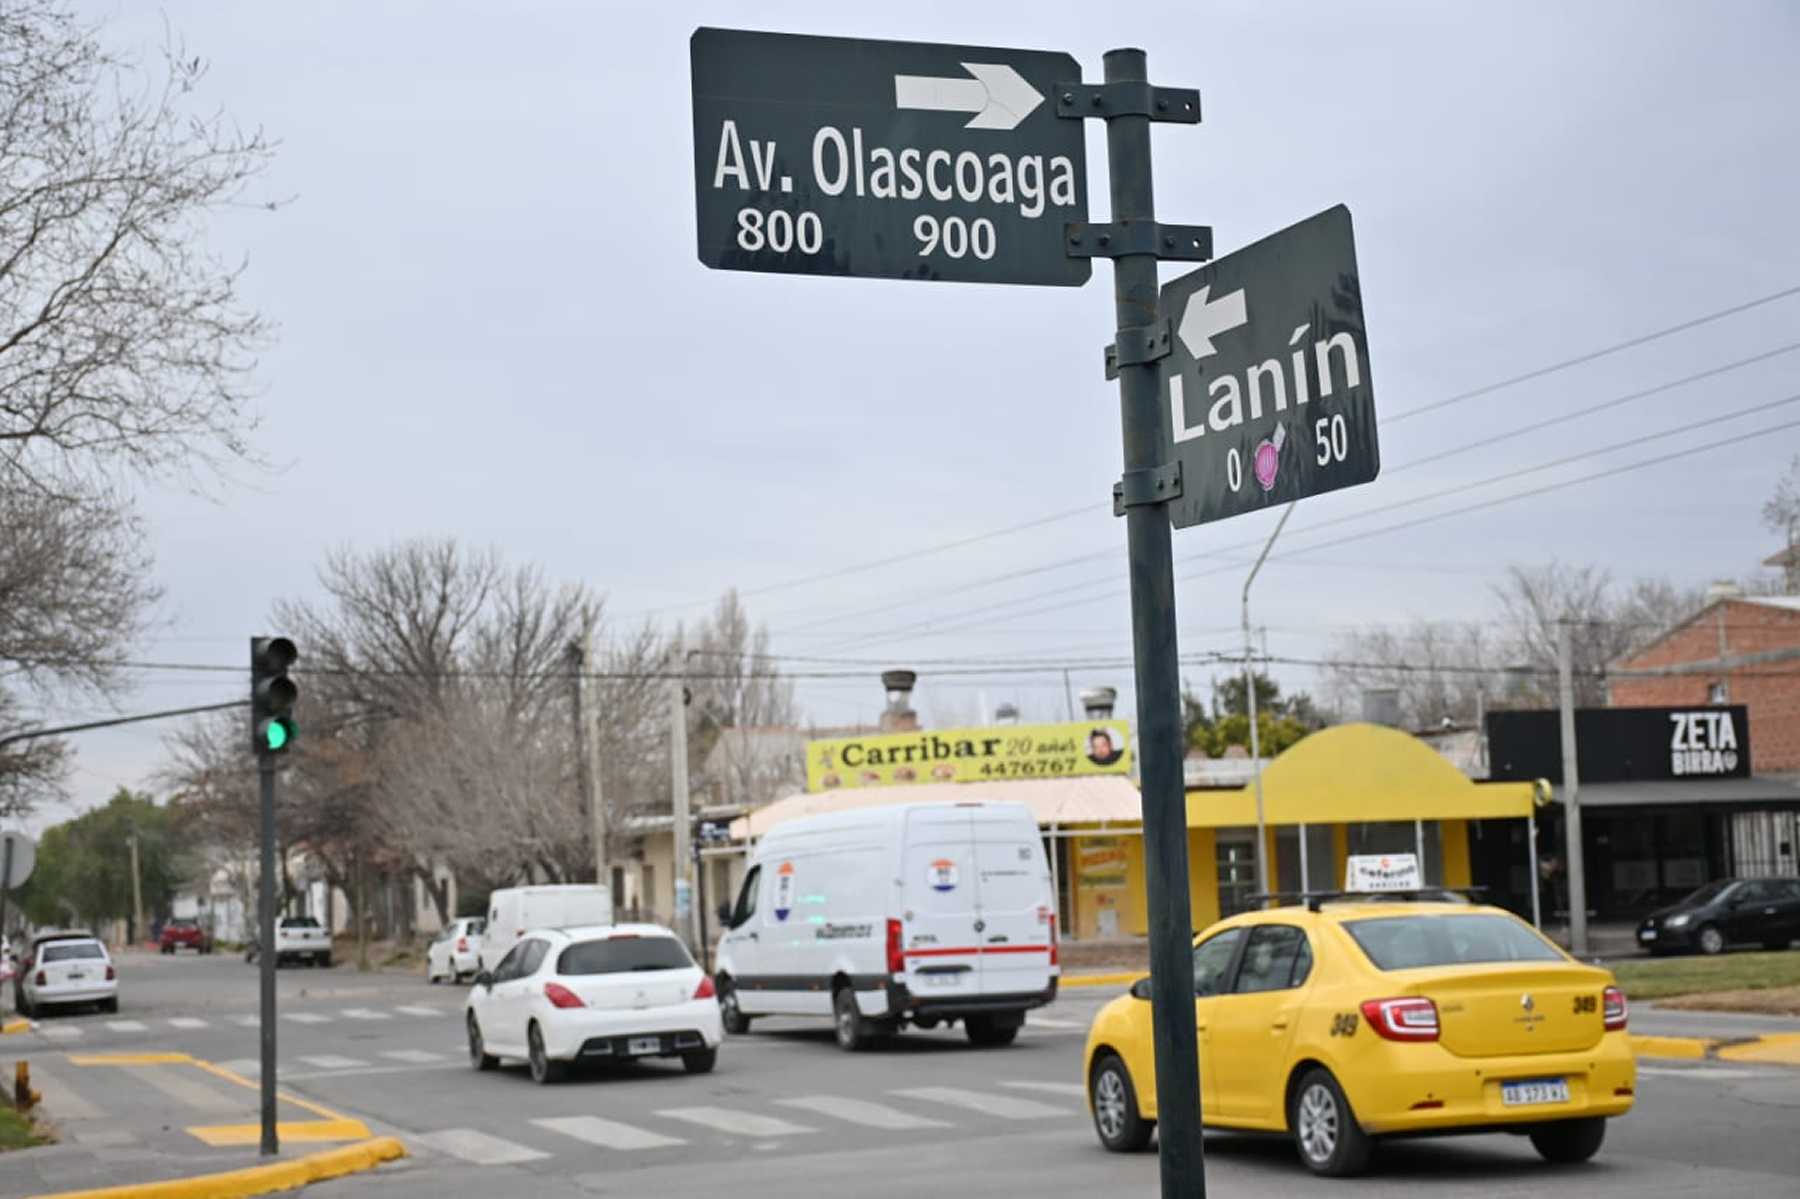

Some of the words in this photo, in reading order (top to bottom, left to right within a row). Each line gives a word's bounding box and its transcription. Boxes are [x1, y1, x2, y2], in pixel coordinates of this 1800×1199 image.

[714, 120, 792, 193] Av.
[812, 126, 1076, 218] Olascoaga
[737, 208, 823, 254] 800
[913, 215, 997, 260] 900
[1169, 323, 1360, 443] Lanín
[1227, 448, 1241, 492] 0
[1316, 414, 1347, 466] 50
[841, 736, 1001, 768] Carribar
[1670, 712, 1737, 750] ZETA
[979, 758, 1077, 776] 4476767
